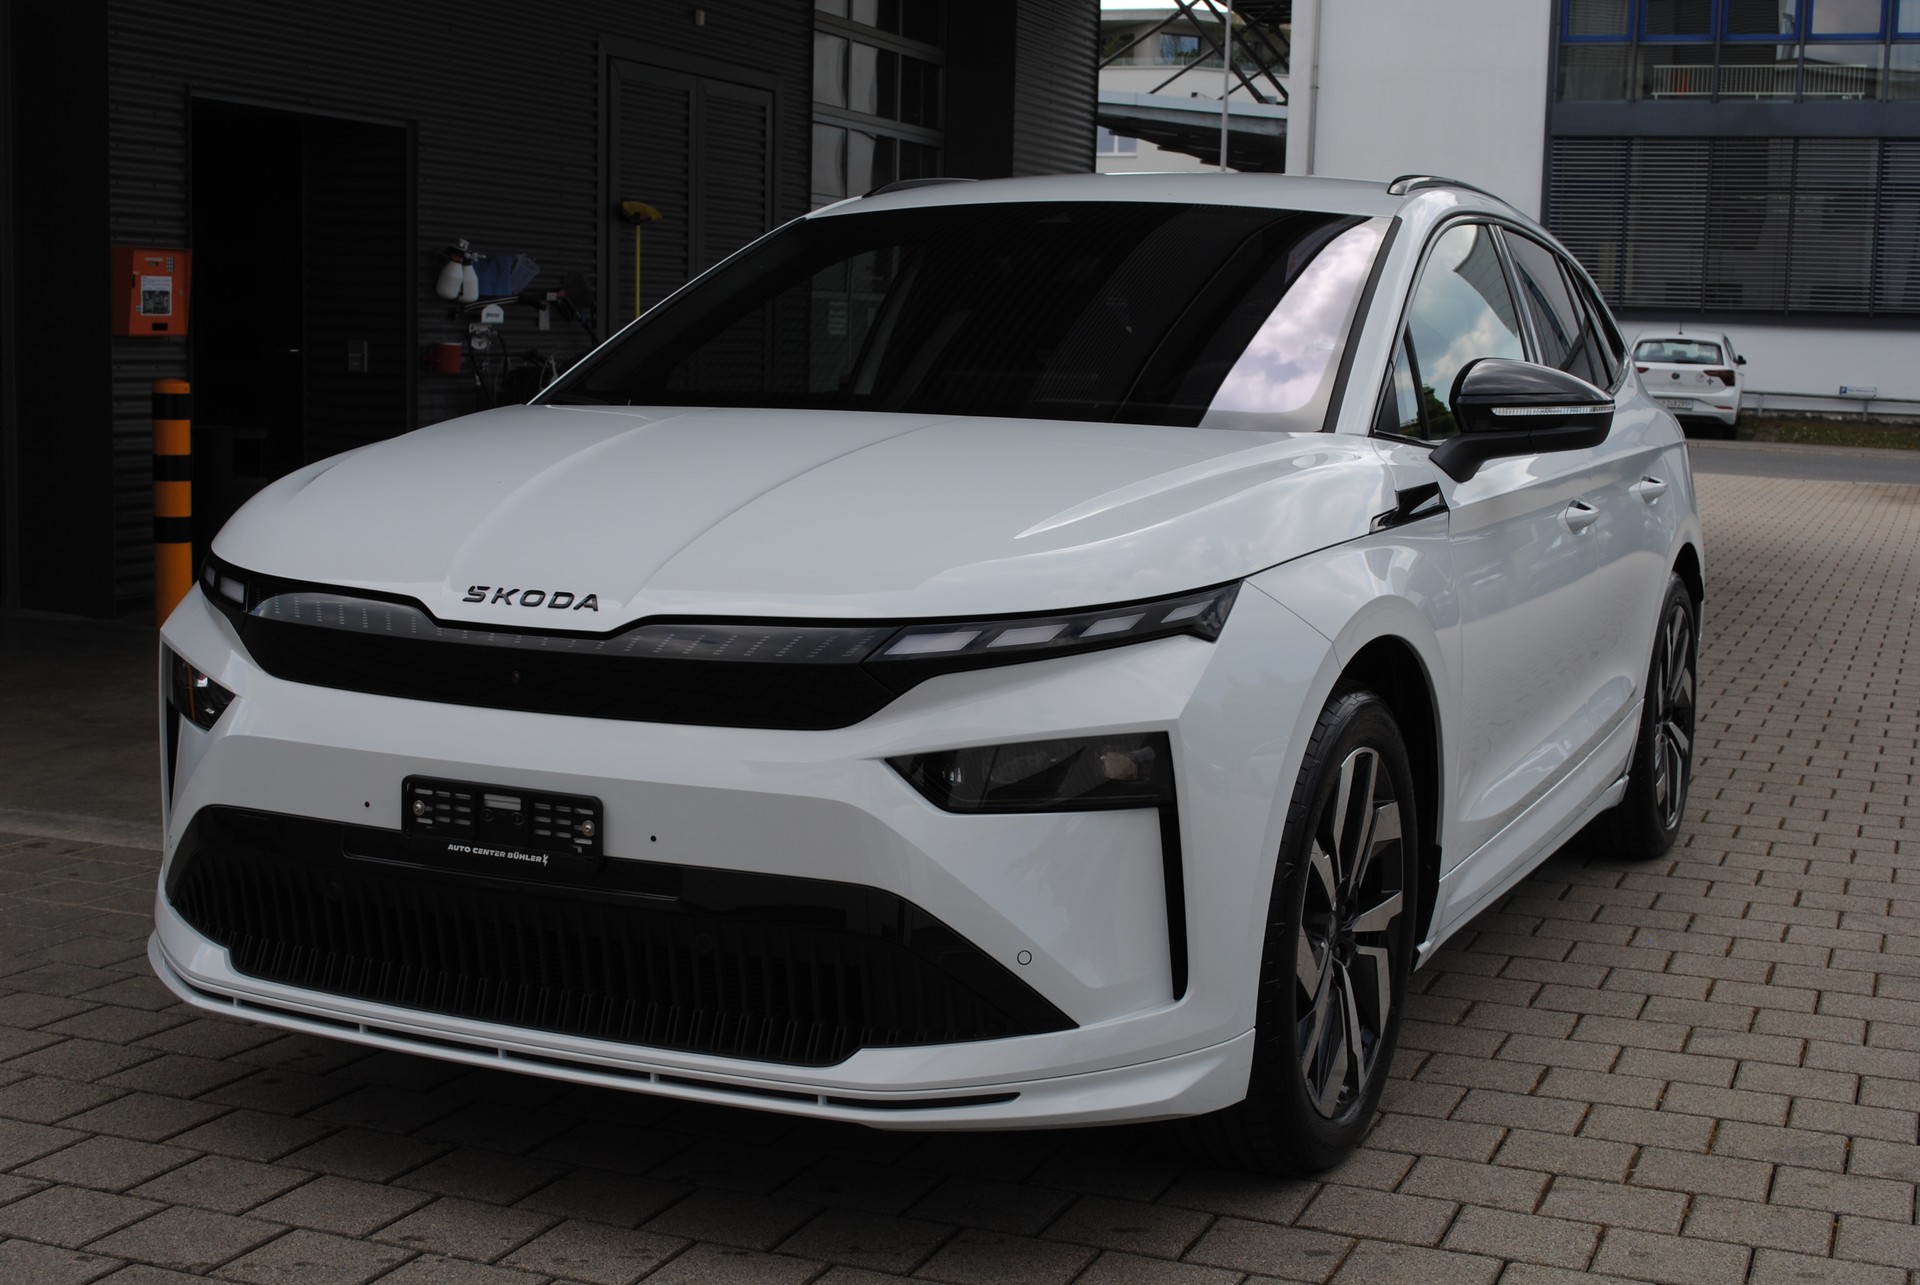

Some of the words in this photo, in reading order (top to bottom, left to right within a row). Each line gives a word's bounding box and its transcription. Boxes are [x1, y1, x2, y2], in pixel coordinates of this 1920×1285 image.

[462, 585, 599, 611] SKODA
[447, 843, 471, 853] AUTO
[472, 847, 506, 858] CENTER
[507, 851, 543, 863] BÜHLER
